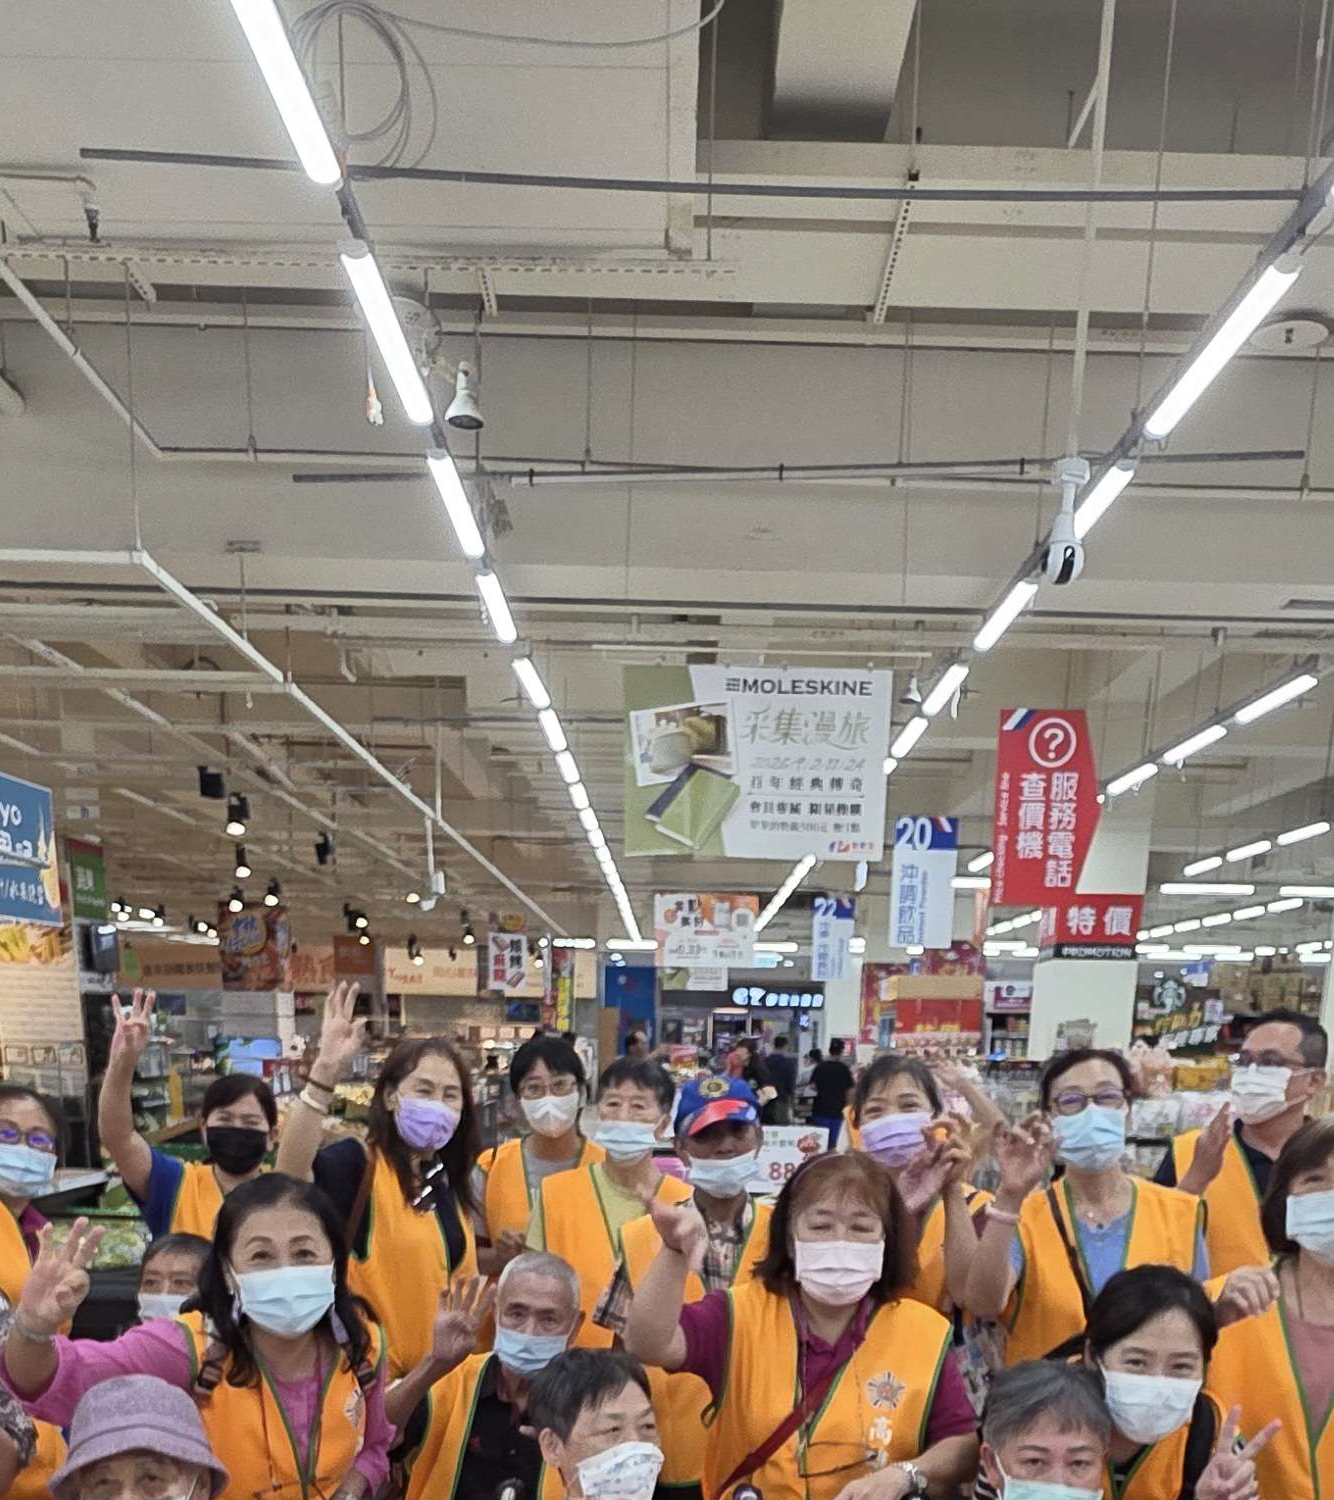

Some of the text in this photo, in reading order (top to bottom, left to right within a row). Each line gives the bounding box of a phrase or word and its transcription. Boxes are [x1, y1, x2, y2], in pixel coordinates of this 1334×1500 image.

[742, 678, 873, 697] MOLESKINE
[1016, 772, 1047, 860] 查價機
[1044, 771, 1079, 888] 服務電話
[895, 817, 933, 851] 20
[813, 896, 838, 918] 22
[1067, 905, 1134, 937] 特價
[1061, 946, 1132, 958] PROMOTION
